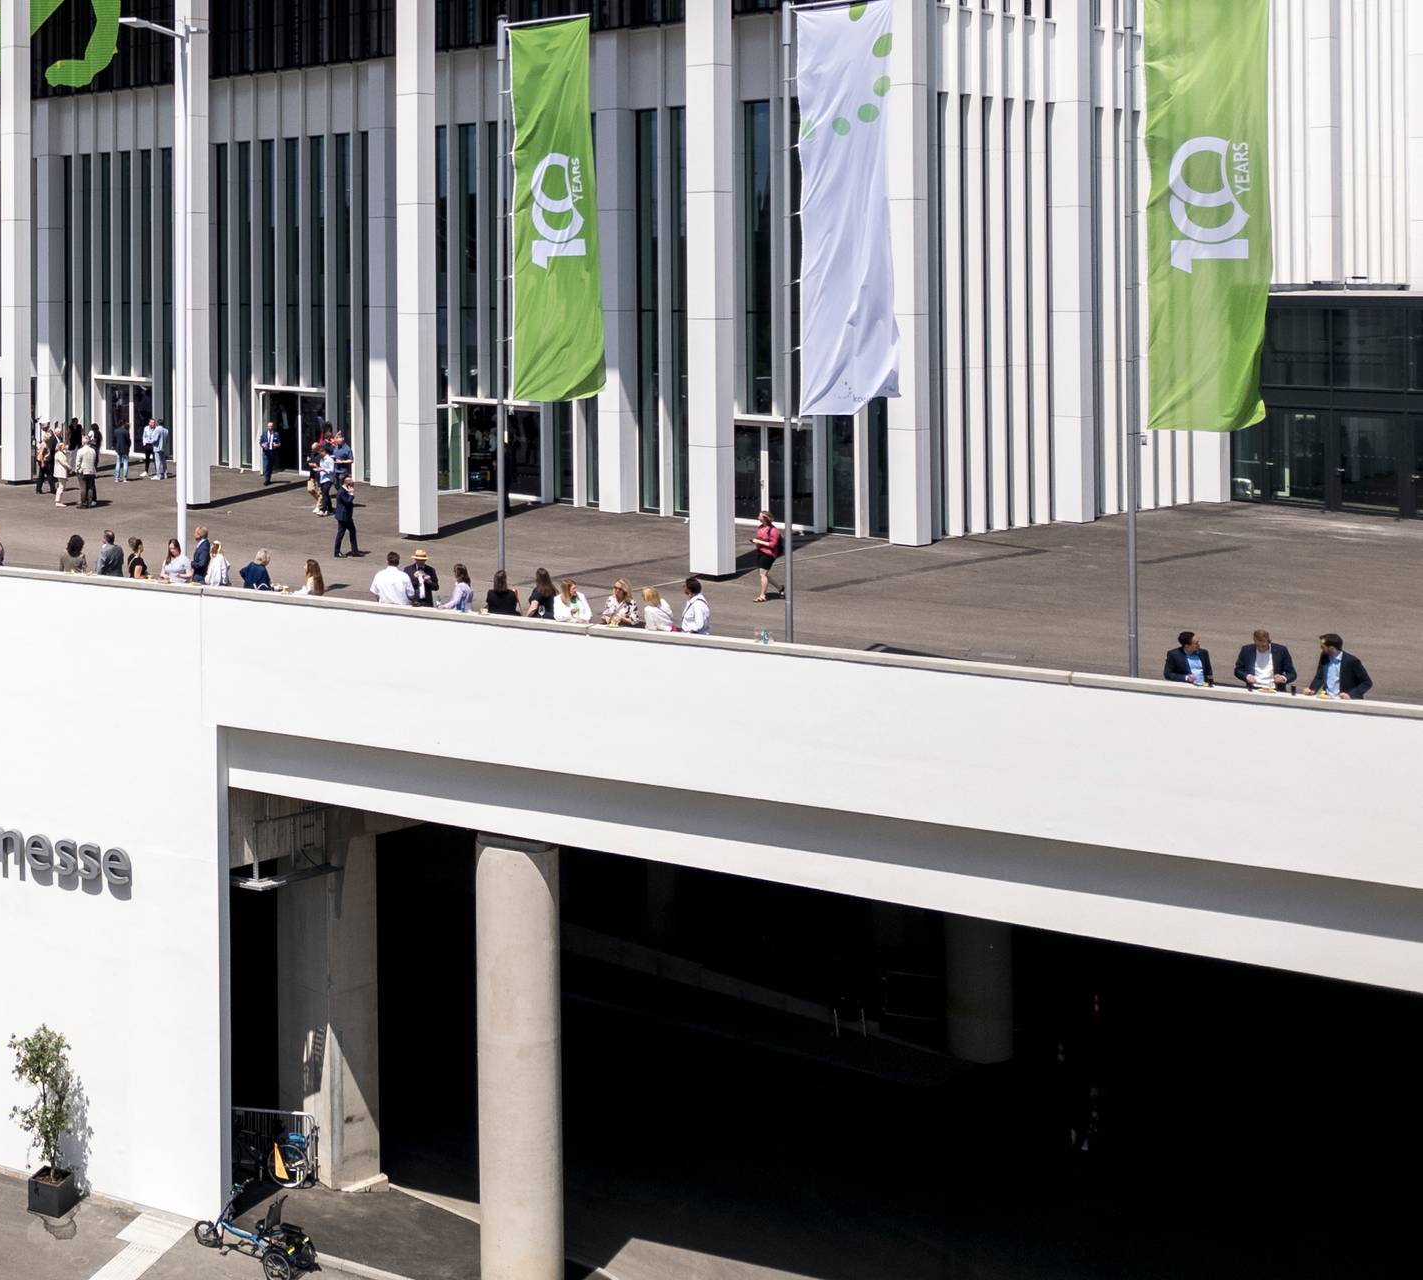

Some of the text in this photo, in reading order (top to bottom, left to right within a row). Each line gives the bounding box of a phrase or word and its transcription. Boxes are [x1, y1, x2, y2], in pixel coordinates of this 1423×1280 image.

[530, 153, 587, 269] 100
[571, 157, 584, 203] YEARS
[1169, 136, 1250, 274] 100
[1233, 142, 1251, 196] YEARS
